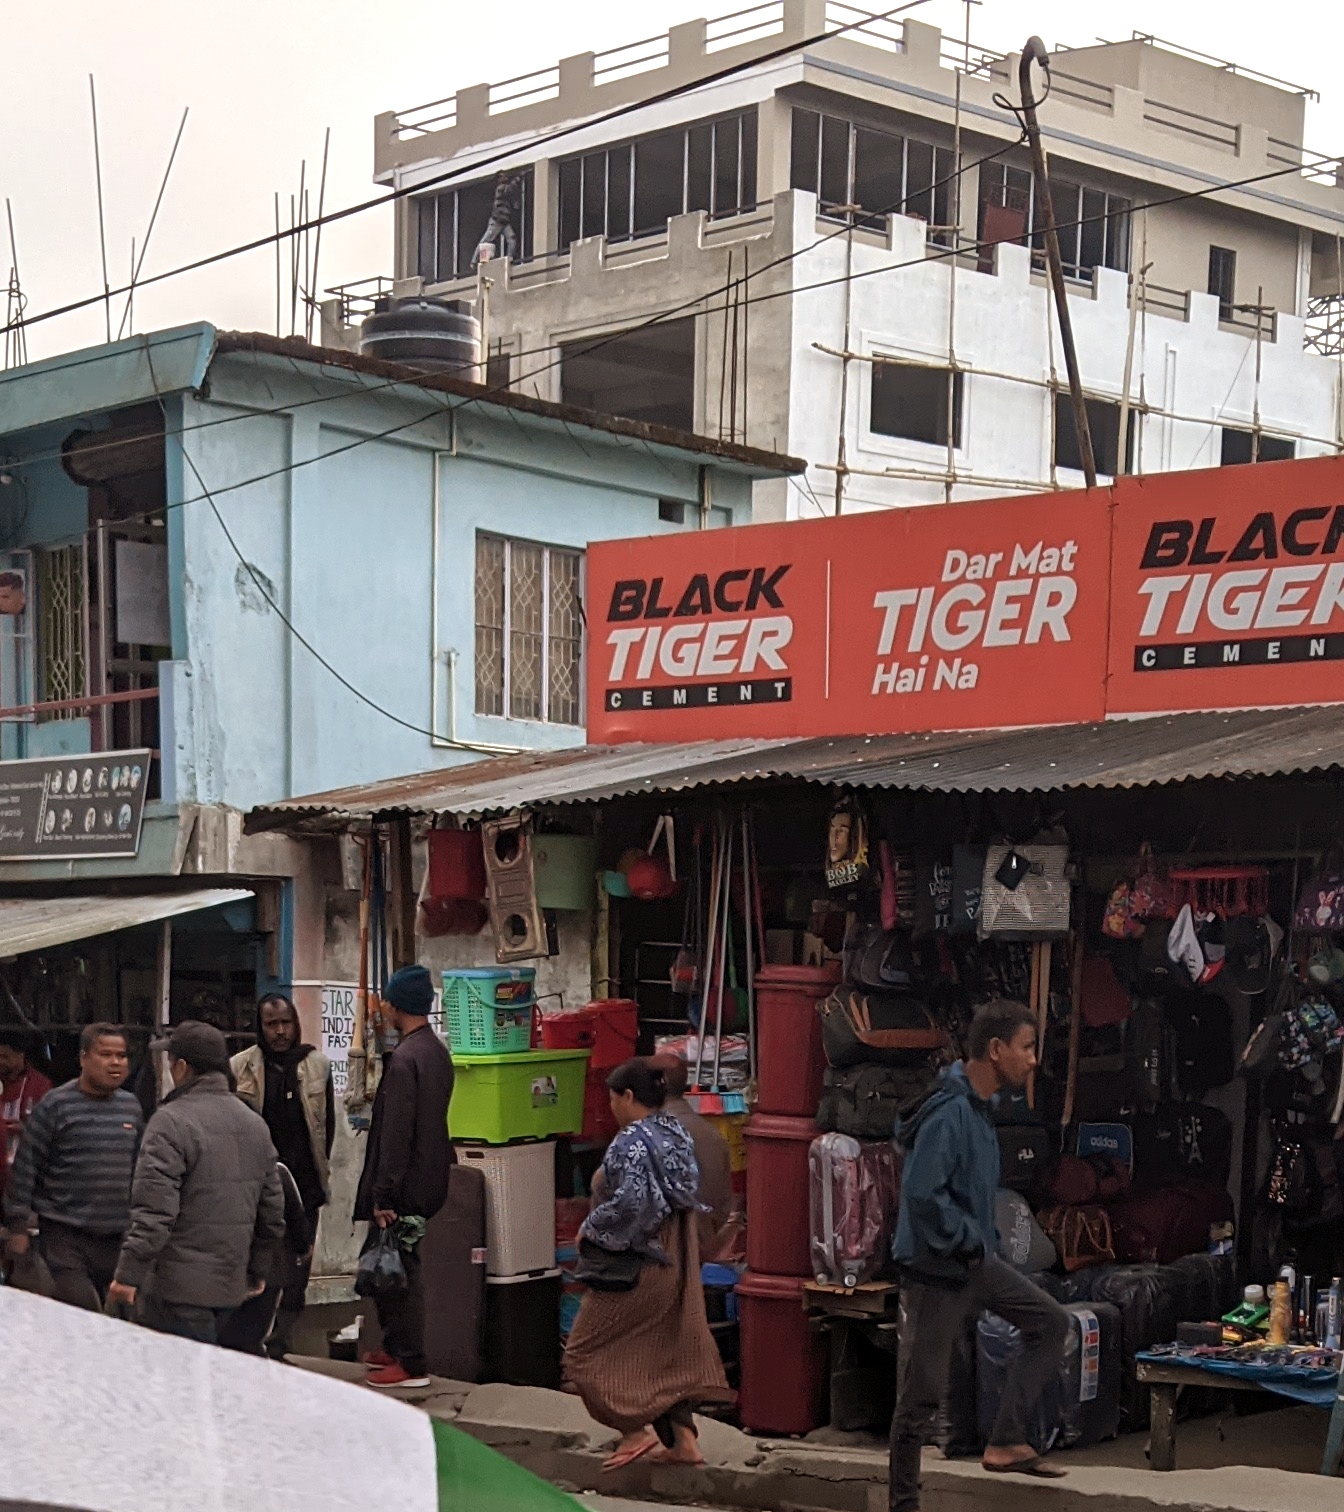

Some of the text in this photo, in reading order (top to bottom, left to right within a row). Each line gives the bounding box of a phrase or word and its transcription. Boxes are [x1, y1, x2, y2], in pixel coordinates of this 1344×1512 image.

[941, 540, 1078, 583] Dar Mat
[606, 563, 793, 622] BLACK
[872, 576, 1078, 656] TIGER
[605, 615, 794, 682] TIGER
[609, 681, 788, 708] CEMENT
[871, 655, 979, 695] Hai Na
[827, 863, 858, 883] BOB
[322, 1016, 356, 1035] INDI
